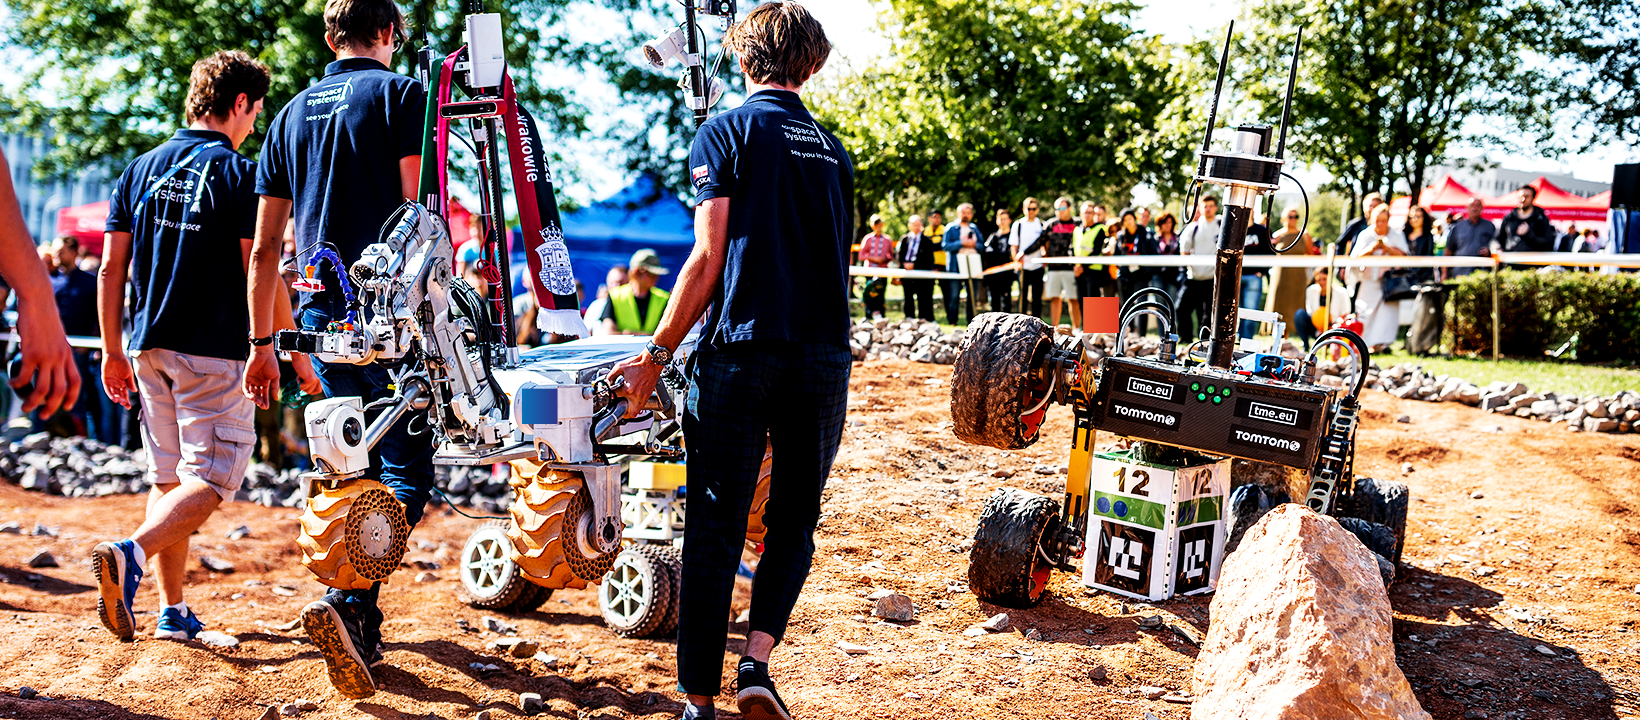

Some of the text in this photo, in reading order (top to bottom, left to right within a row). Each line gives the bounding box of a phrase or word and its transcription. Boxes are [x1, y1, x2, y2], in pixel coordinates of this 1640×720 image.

[307, 93, 342, 106] systems
[317, 87, 342, 98] space
[784, 132, 820, 143] systems
[791, 127, 816, 136] space
[823, 155, 838, 164] space
[1132, 380, 1169, 396] tme.eu
[1114, 404, 1166, 424] TOMTOM
[1254, 405, 1293, 421] tme.eu
[1235, 429, 1290, 449] TOMTOM
[1113, 466, 1150, 497] 12
[1191, 468, 1213, 496] 12
